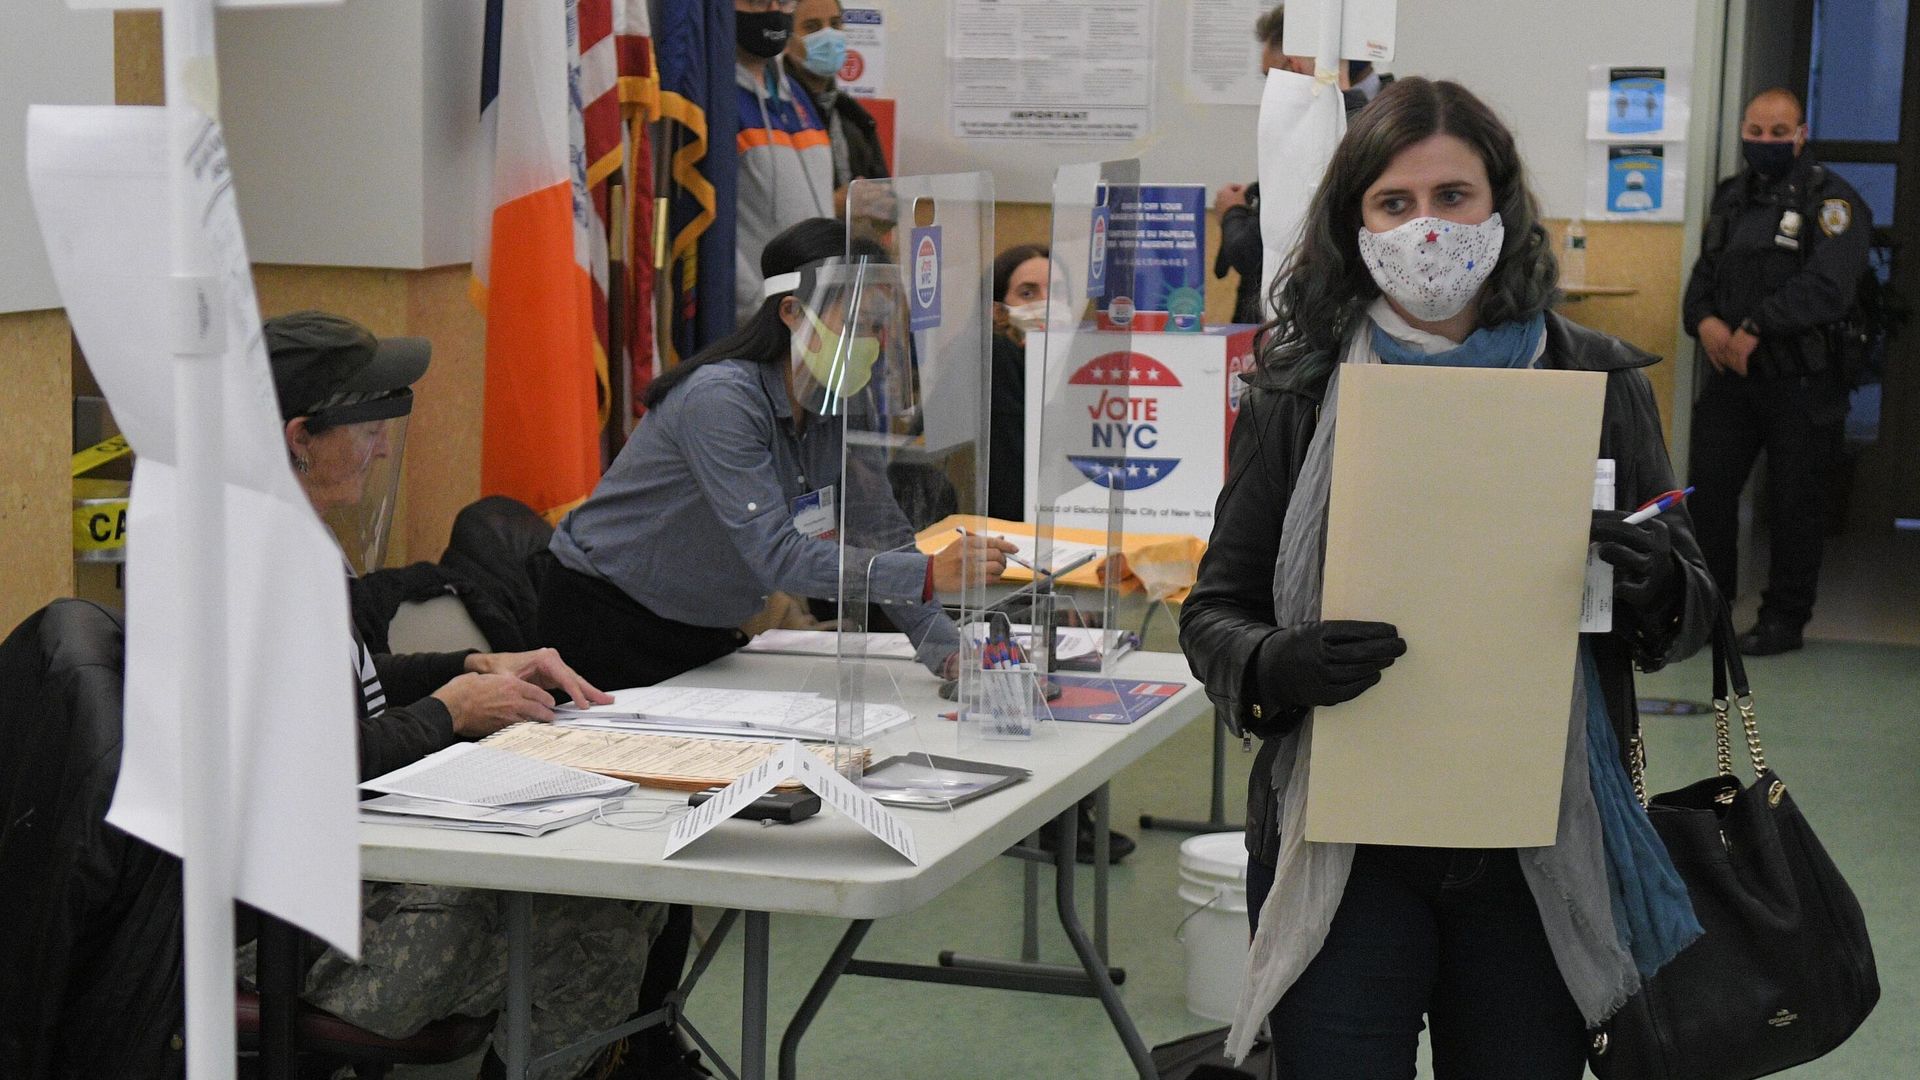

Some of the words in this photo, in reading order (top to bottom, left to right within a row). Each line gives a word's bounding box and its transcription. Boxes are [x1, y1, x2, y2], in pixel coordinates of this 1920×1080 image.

[1088, 389, 1157, 421] VOTE
[1092, 423, 1158, 449] NYC
[1139, 507, 1157, 517] City
[1171, 508, 1190, 517] New
